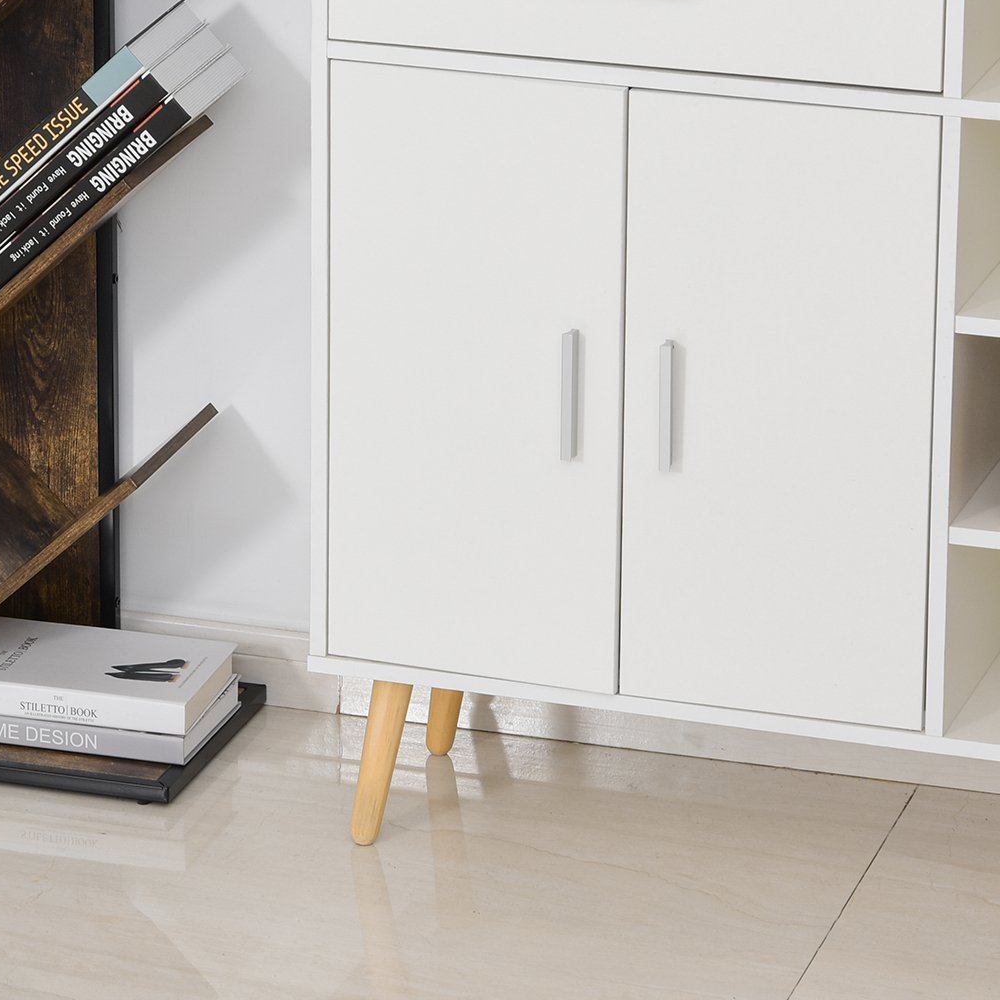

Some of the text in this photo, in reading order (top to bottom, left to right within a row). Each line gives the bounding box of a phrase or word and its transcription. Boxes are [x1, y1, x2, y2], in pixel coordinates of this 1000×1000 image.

[4, 133, 48, 177] SPEED
[42, 96, 88, 141] ISSUE
[66, 104, 134, 168] BRINGING
[48, 165, 67, 184] Have
[9, 129, 157, 262] BRINGING Have Found it lacking
[26, 181, 49, 204] Found
[15, 202, 27, 212] it
[19, 701, 98, 718] STILETTO BOOK
